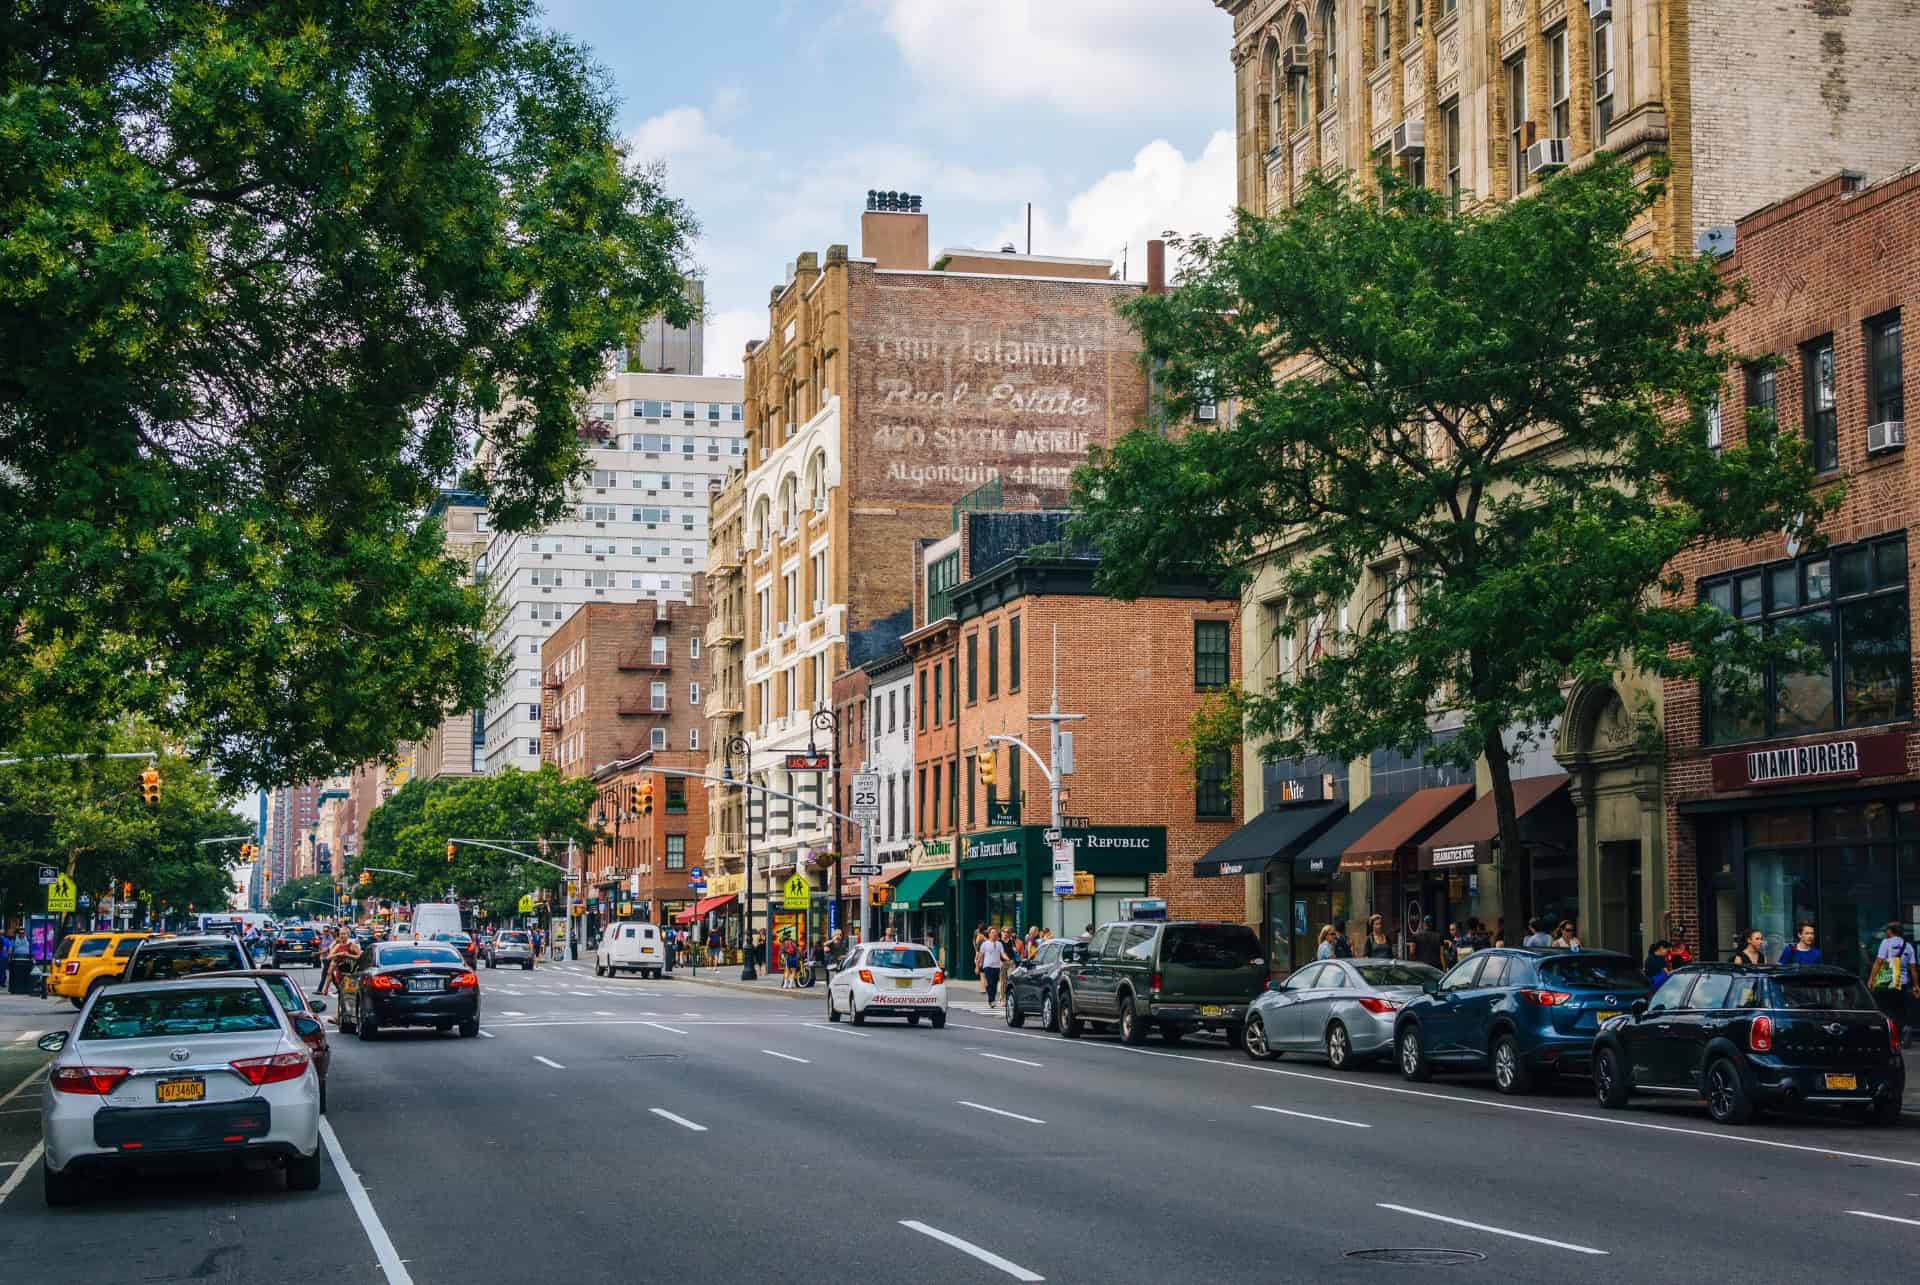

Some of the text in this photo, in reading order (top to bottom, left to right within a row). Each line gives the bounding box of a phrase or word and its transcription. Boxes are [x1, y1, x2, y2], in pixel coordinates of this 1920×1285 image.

[934, 427, 1010, 452] SIXTH
[1013, 430, 1089, 454] AVENUE
[1747, 740, 1859, 782] UMAMI BURGER
[856, 792, 876, 805] 25
